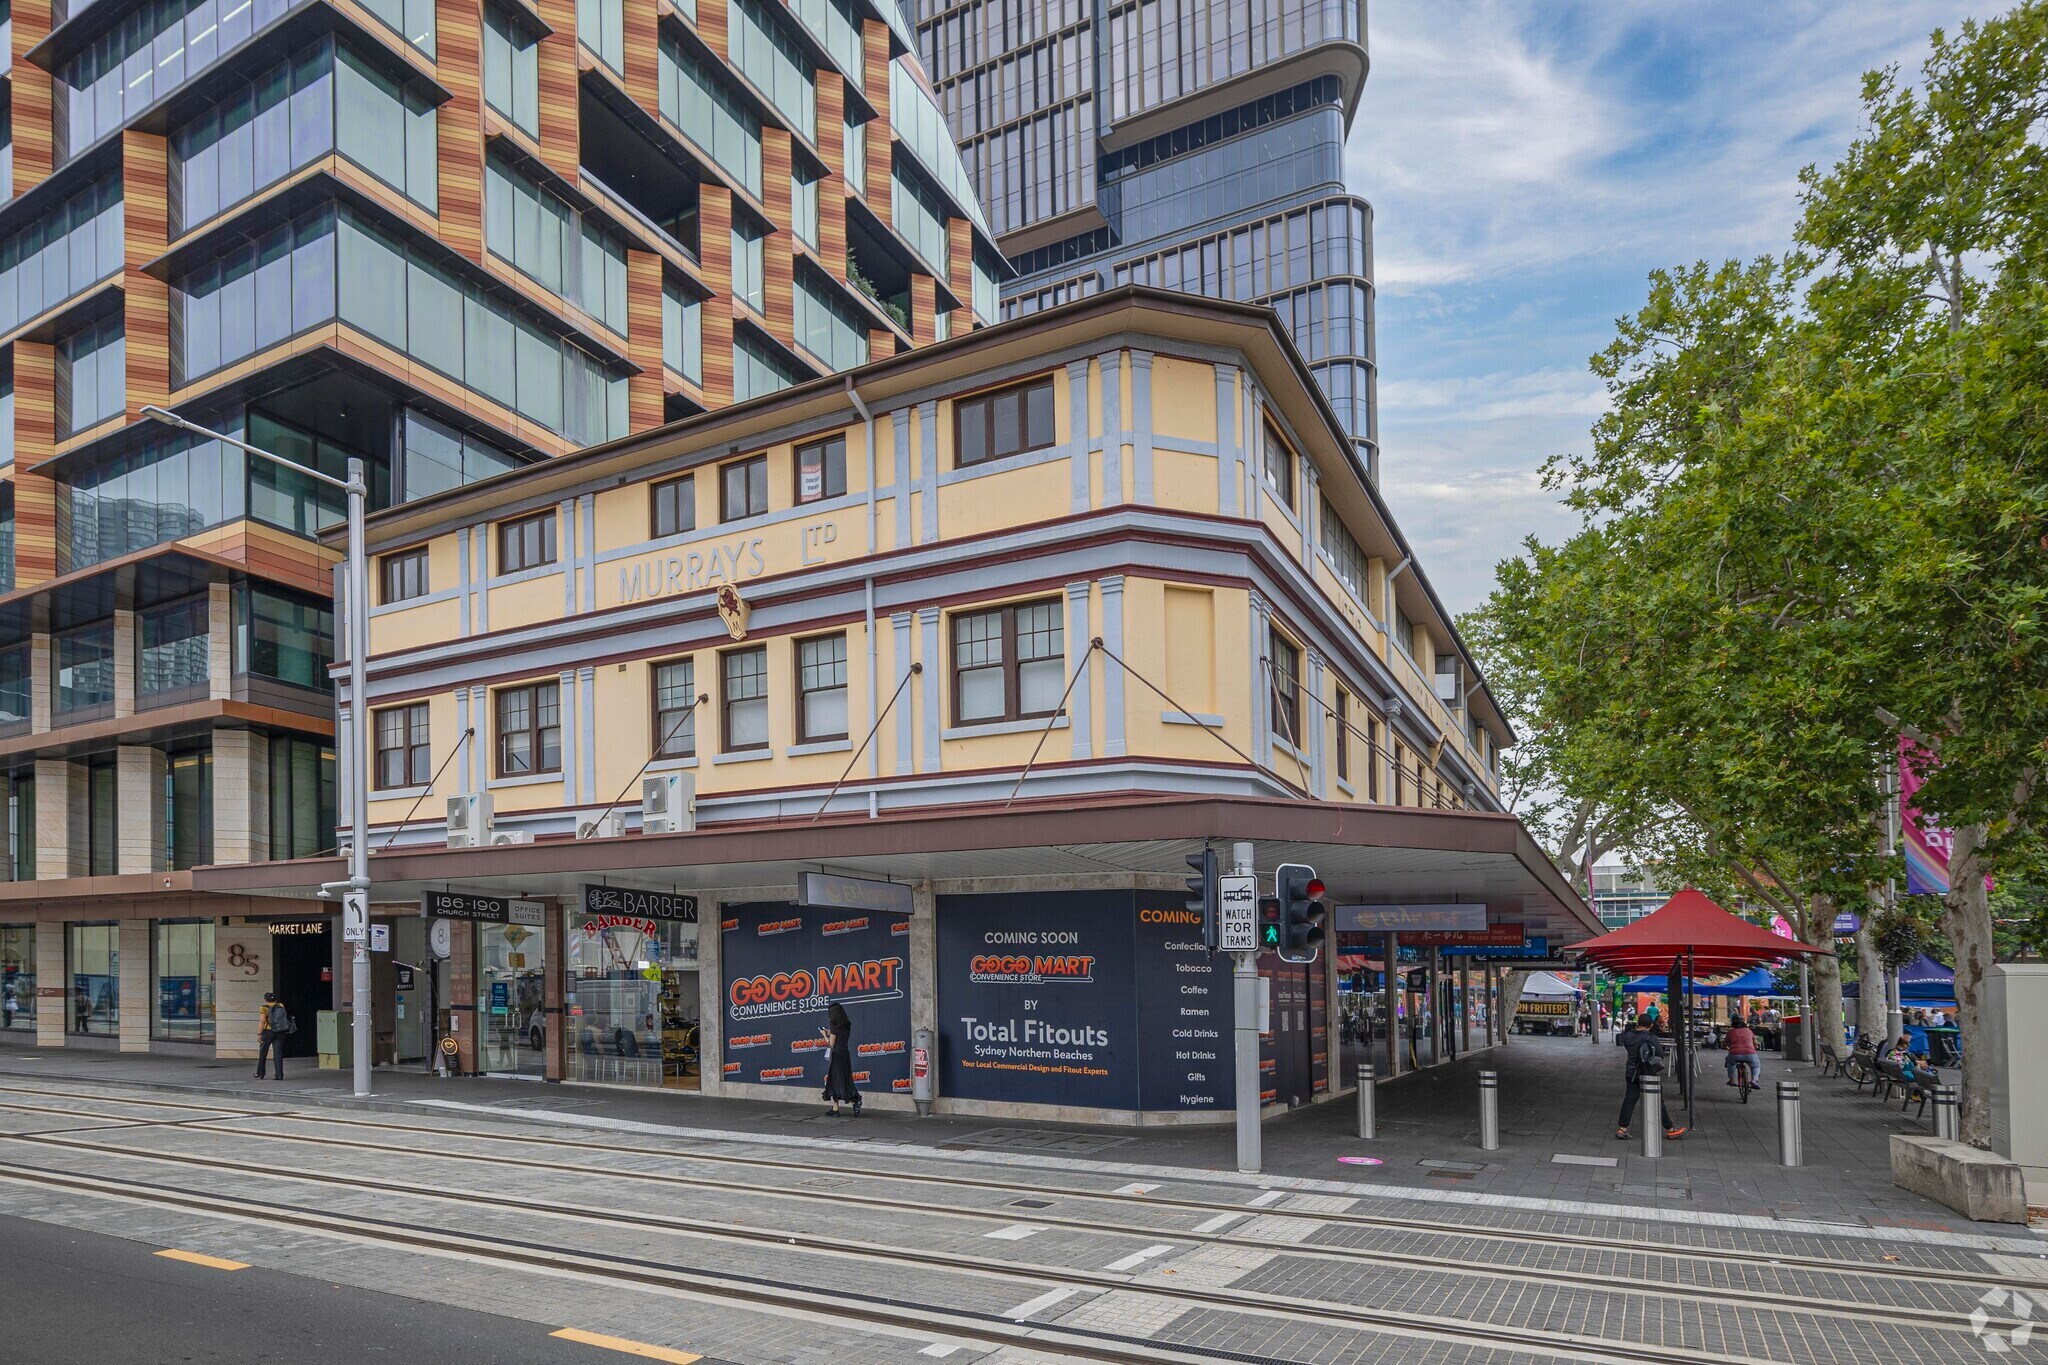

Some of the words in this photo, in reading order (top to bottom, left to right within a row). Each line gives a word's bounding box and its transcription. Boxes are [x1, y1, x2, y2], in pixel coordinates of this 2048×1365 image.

[619, 537, 765, 604] MURRAYS
[801, 520, 837, 567] LTD
[437, 896, 500, 912] 186-190
[514, 905, 541, 914] OFFICE
[623, 892, 695, 920] BARBER
[437, 908, 469, 917] CHURCH
[472, 911, 500, 919] STREET
[514, 912, 541, 921] SUITES
[1139, 909, 1202, 925] COMING
[1225, 909, 1252, 920] WATCH
[268, 924, 300, 935] MARKET
[301, 923, 322, 934] LANE
[345, 927, 365, 936] ONLY
[583, 914, 657, 940] BARBER
[1225, 922, 1251, 933] FOR
[984, 931, 1037, 944] COMING
[1041, 931, 1078, 944] SOON
[1225, 935, 1252, 947] TRAMS
[227, 943, 259, 976] 85
[971, 956, 1031, 975] GOGO
[1035, 956, 1093, 975] MART
[1175, 963, 1213, 973] Tobacco
[731, 971, 811, 1005] GOGO
[818, 958, 898, 995] MART
[971, 973, 1018, 981] CONVENIENCE
[1020, 974, 1042, 982] STORE
[1180, 985, 1209, 995] Coffee
[732, 1001, 797, 1017] CONVENIENCE
[799, 995, 829, 1008] STORE
[1024, 1000, 1038, 1010] BY
[1530, 1003, 1568, 1014] FRITTERS
[1180, 1007, 1210, 1016] Ramen
[961, 1017, 1017, 1043] Total
[1025, 1019, 1109, 1047] Fitouts
[1172, 1029, 1192, 1038] Cold
[1194, 1029, 1219, 1038] Drinks
[974, 1044, 1006, 1058] Sydney
[1009, 1046, 1051, 1059] Northern
[1053, 1048, 1094, 1061] Beaches
[1175, 1051, 1190, 1060] Hot
[1191, 1051, 1217, 1060] Drinks
[962, 1059, 975, 1068] Your
[976, 1060, 992, 1069] Local
[993, 1062, 1028, 1071] Commercial
[1029, 1063, 1050, 1074] Design
[1050, 1064, 1062, 1073] and
[1064, 1065, 1083, 1074] Fitout
[1083, 1066, 1109, 1077] Experts
[1187, 1072, 1206, 1082] Gifts
[1180, 1094, 1215, 1105] Hygiene
